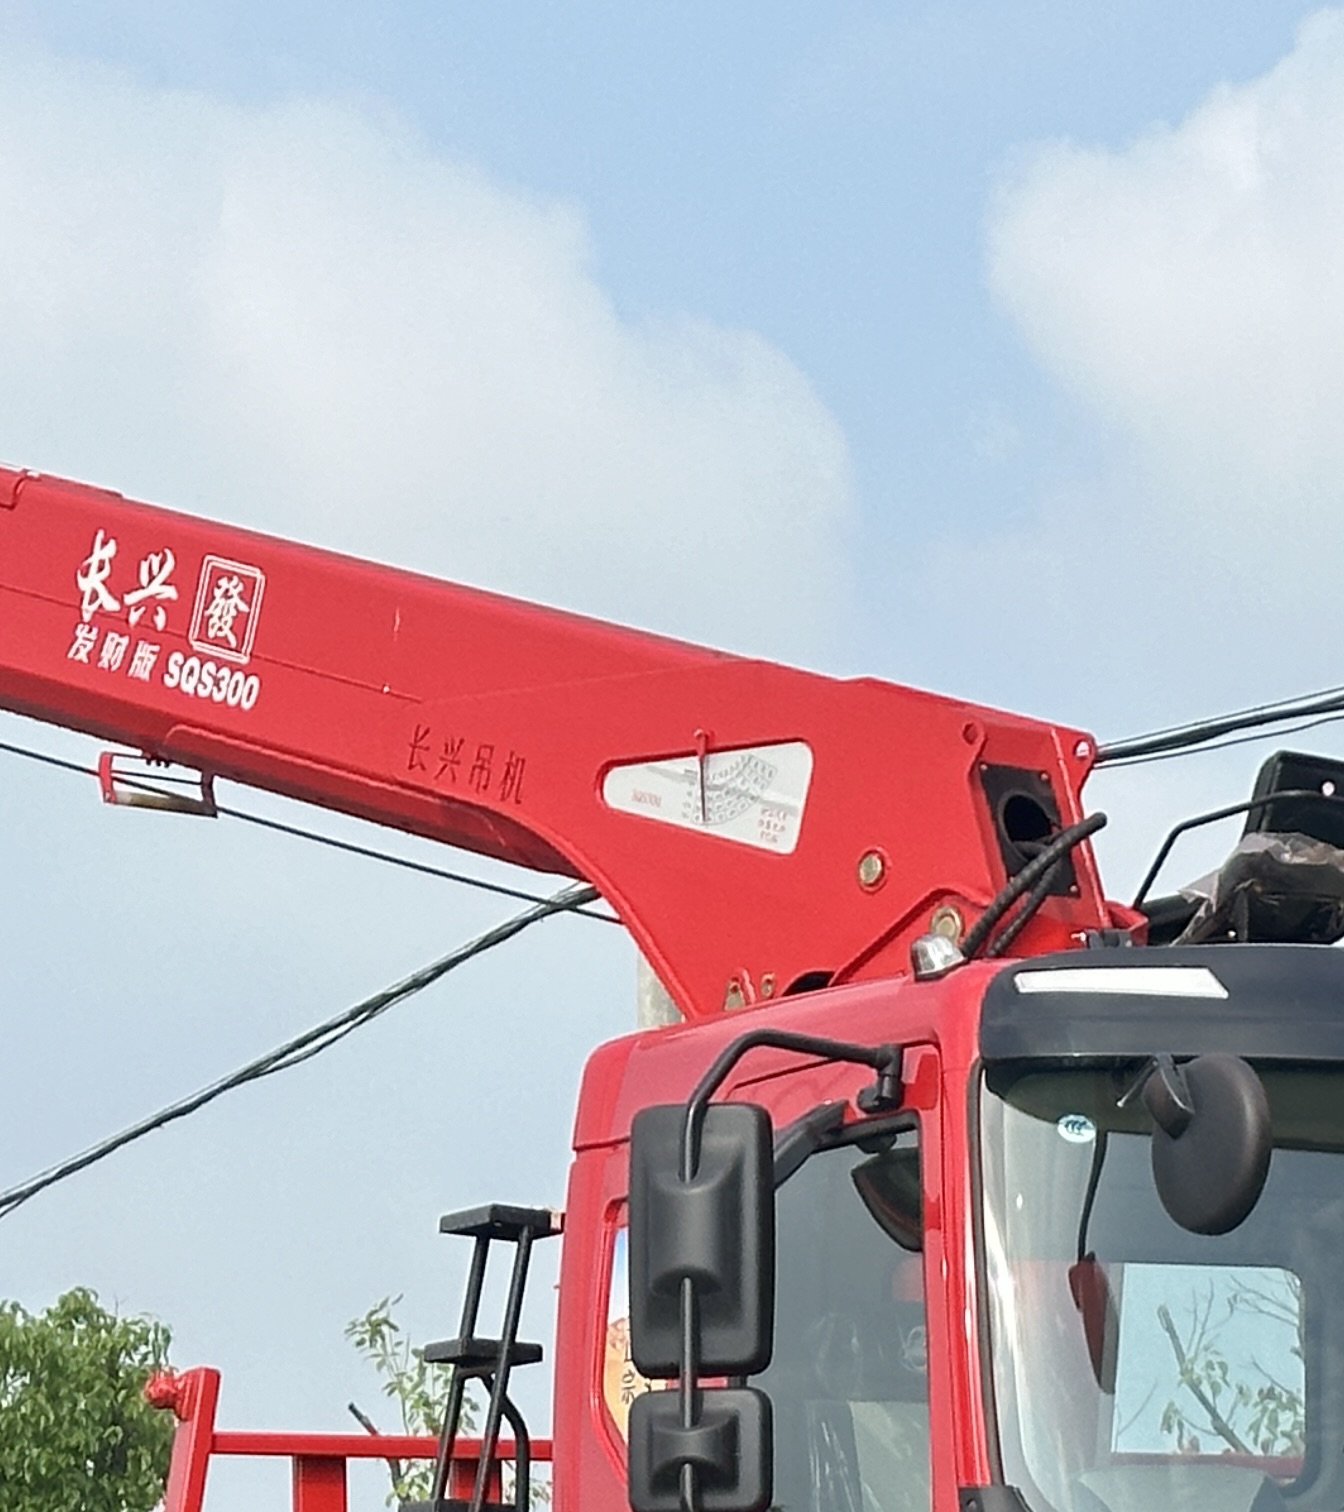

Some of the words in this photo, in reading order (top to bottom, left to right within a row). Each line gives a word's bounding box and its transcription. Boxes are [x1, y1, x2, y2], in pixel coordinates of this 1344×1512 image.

[76, 528, 180, 632] 长兴
[204, 574, 251, 649] 發
[67, 622, 161, 683] 发财版
[163, 651, 261, 711] SQS300
[406, 723, 527, 806] 长兴吊机
